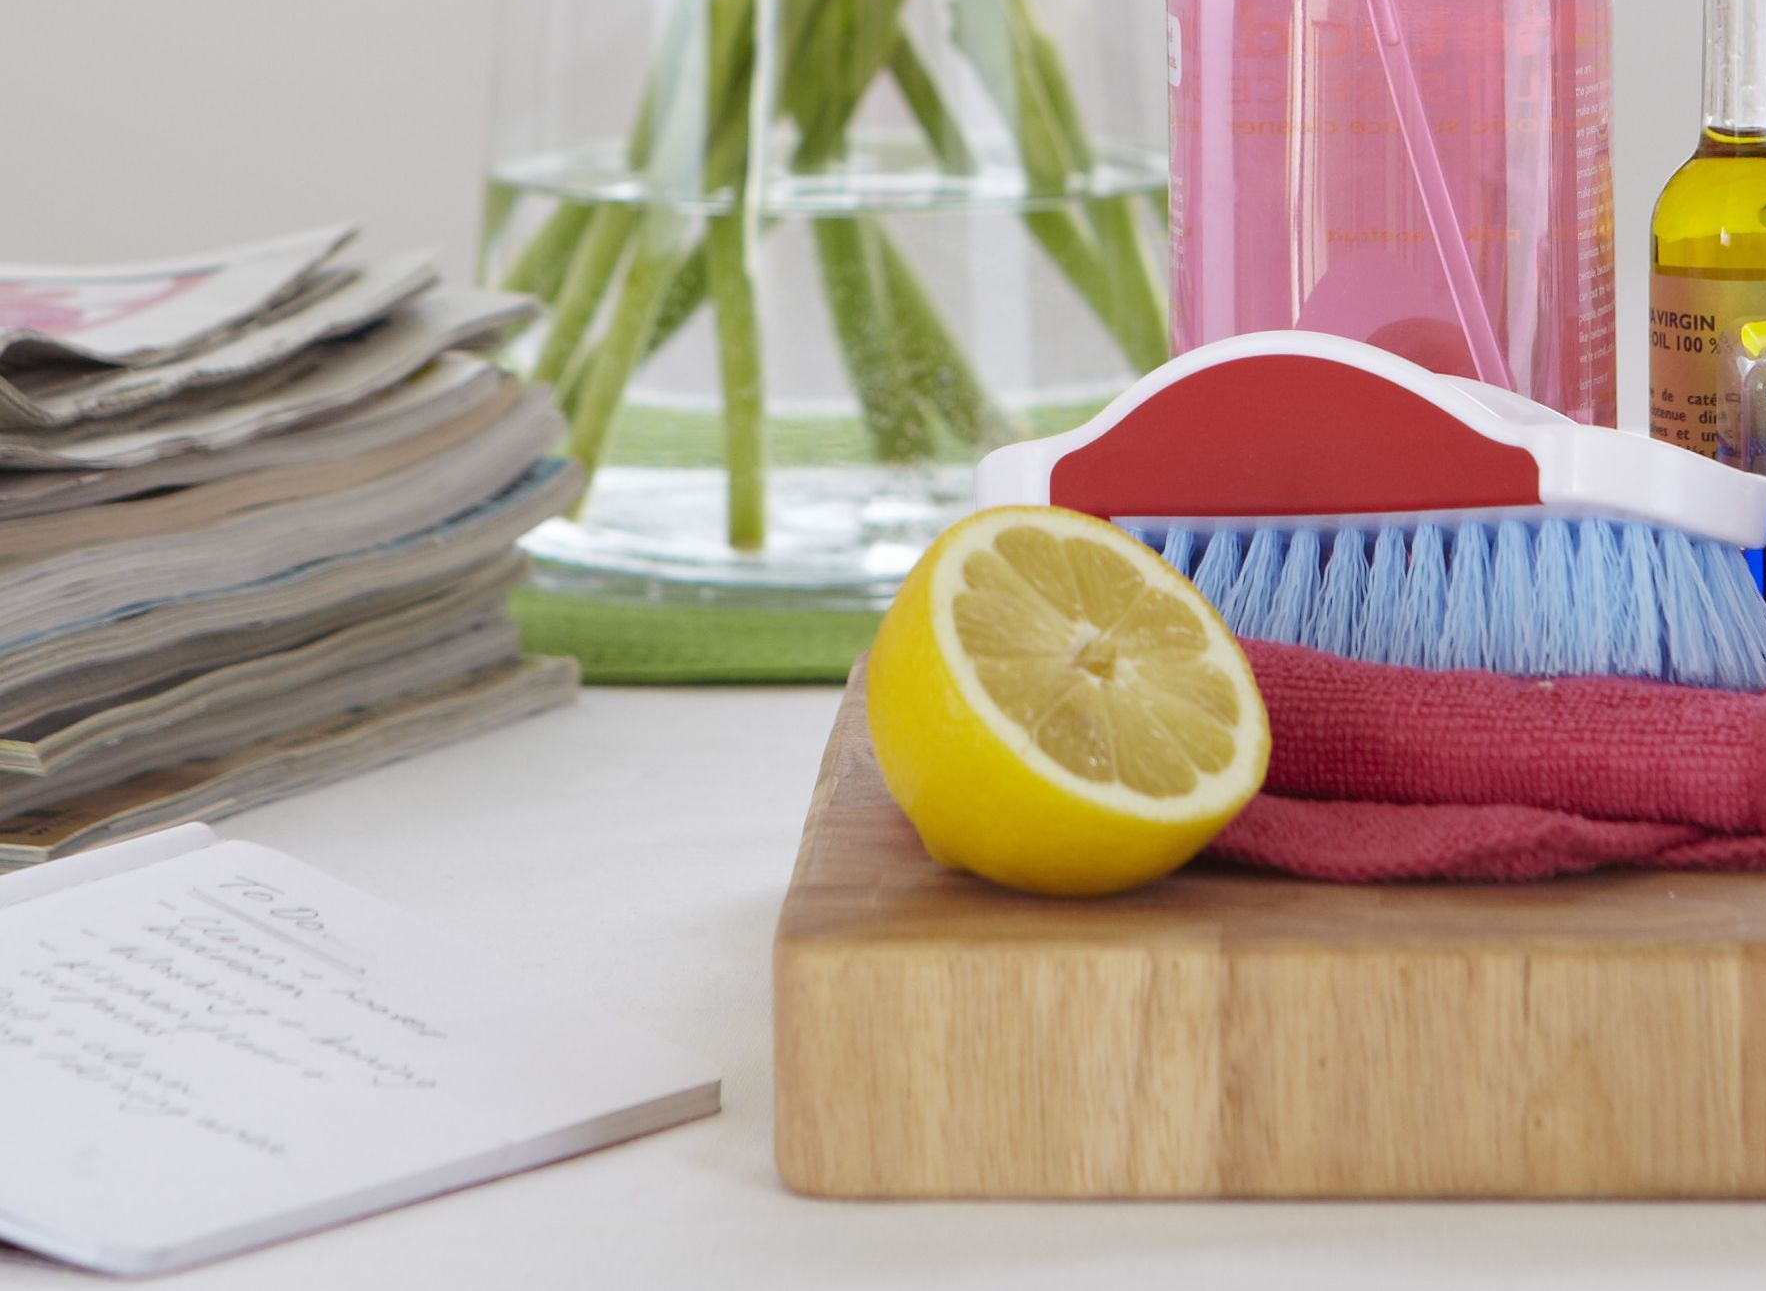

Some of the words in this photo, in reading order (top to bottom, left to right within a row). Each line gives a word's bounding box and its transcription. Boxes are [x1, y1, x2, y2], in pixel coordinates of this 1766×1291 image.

[1657, 310, 1716, 332] VIRGIN
[1652, 330, 1671, 350] OIL
[1676, 334, 1703, 353] 100
[1687, 392, 1717, 406] caté
